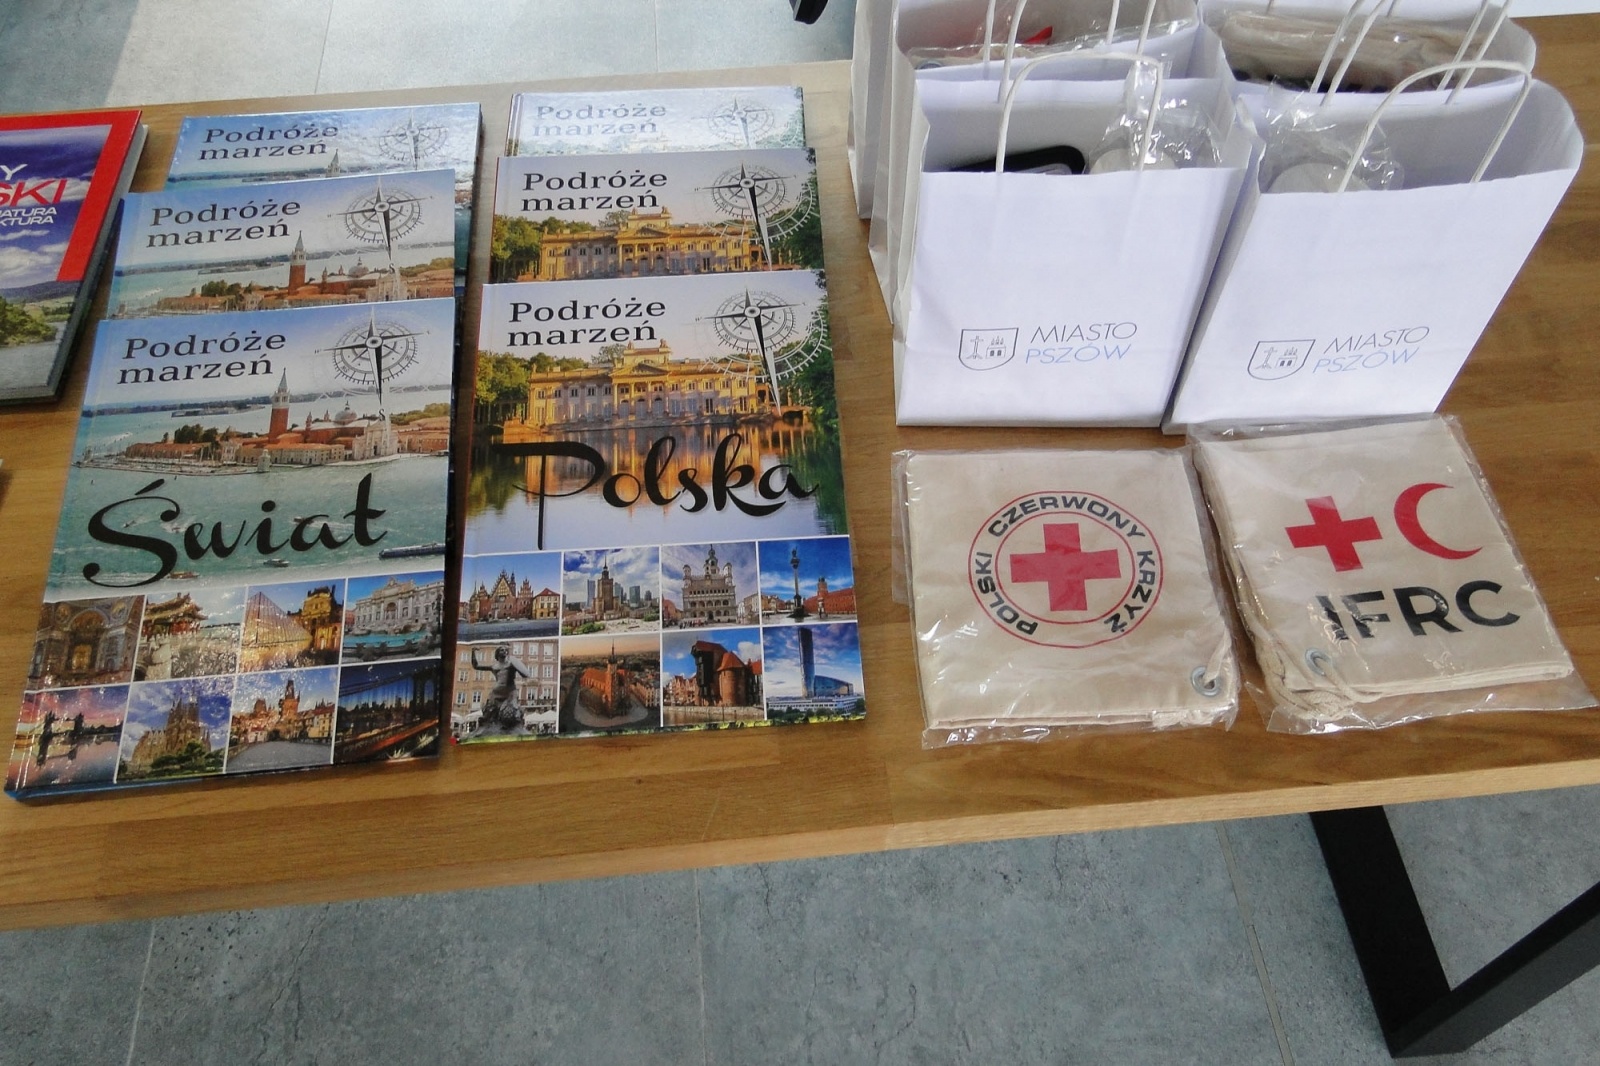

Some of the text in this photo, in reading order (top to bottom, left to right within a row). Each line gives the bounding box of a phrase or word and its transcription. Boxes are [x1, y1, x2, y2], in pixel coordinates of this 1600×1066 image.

[536, 103, 667, 121] Podróże
[203, 123, 339, 144] Podróże
[532, 120, 658, 137] marzeń
[199, 138, 327, 161] marzeń
[522, 169, 668, 191] Podróże
[149, 198, 302, 227] Podróże
[520, 190, 660, 212] marzeń
[145, 219, 290, 248] marzeń
[508, 297, 667, 323] Podróże
[122, 329, 286, 360] Podróże
[506, 320, 658, 347] marzeń
[1030, 322, 1138, 344] MIASTO
[1323, 326, 1430, 355] MIASTO
[1025, 342, 1132, 364] PSZÓW
[1312, 346, 1420, 374] PSZÓW
[117, 353, 274, 385] marzeń
[491, 432, 820, 551] Polska
[82, 472, 388, 588] Świat
[975, 495, 1156, 635] POLSKI CZERWONY KRZYŻ
[1315, 580, 1521, 640] IFRC
